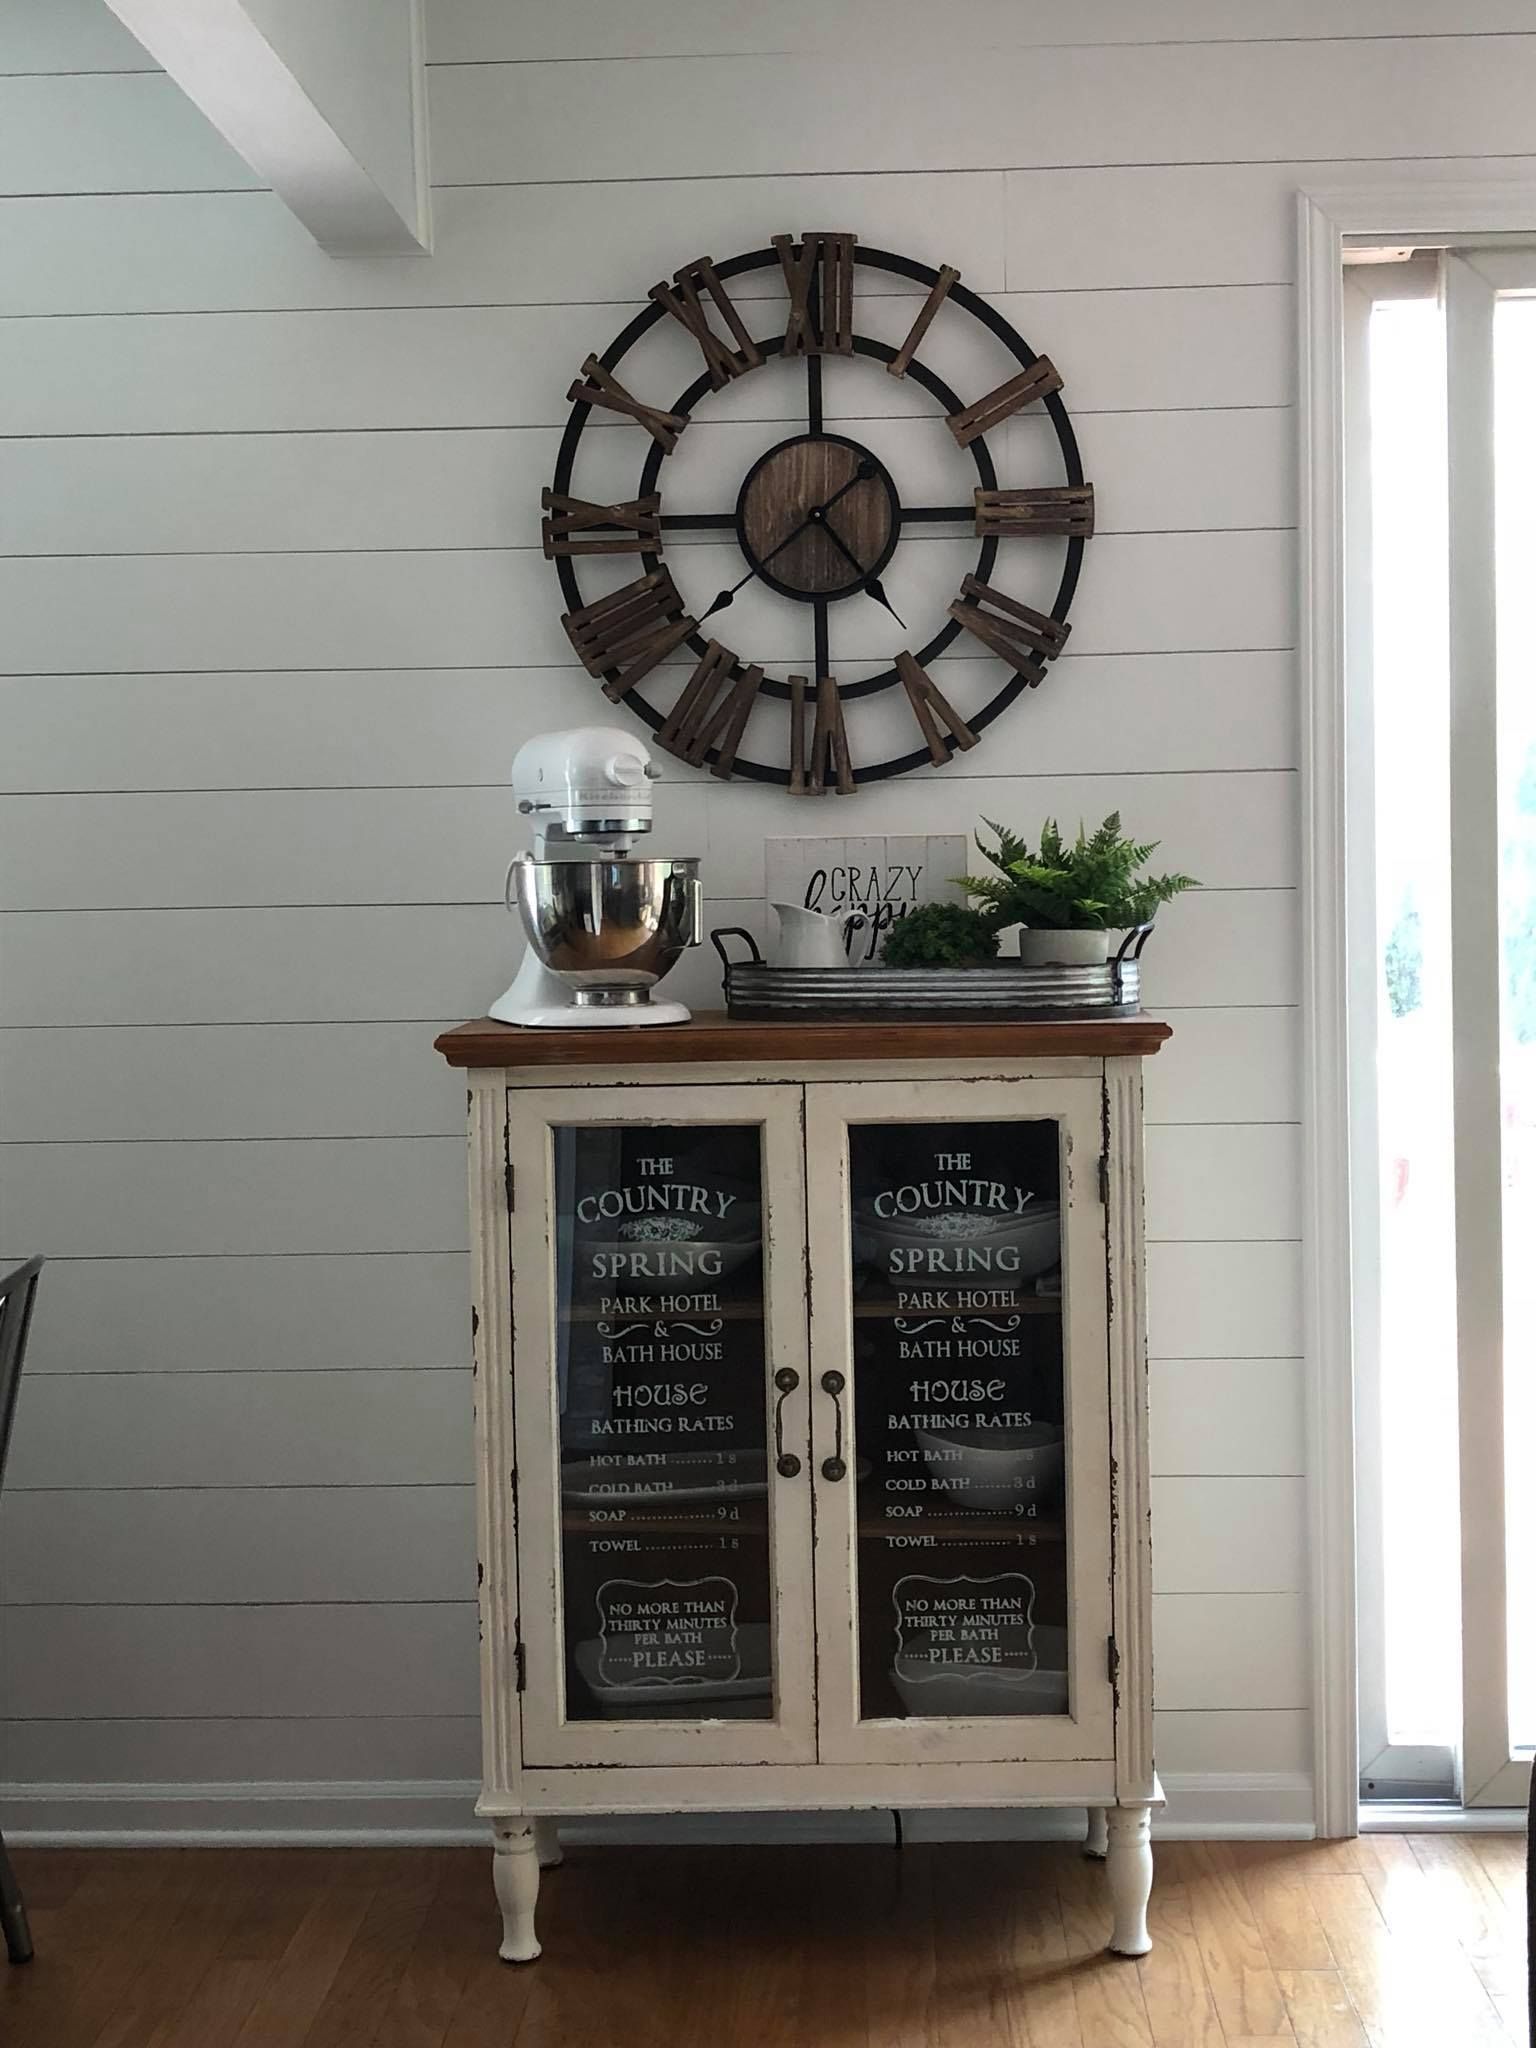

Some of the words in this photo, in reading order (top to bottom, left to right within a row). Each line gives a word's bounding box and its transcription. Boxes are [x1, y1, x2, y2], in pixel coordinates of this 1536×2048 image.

[831, 866, 923, 901] CRAZY
[637, 1158, 674, 1175] THE
[934, 1153, 971, 1170] THE
[577, 1184, 736, 1223] COUNTRY
[874, 1180, 1035, 1218] COUNTRY
[592, 1251, 723, 1279] SPRING
[889, 1246, 1021, 1273] SPRING
[601, 1296, 653, 1314] PARK
[661, 1294, 722, 1312] HOTEL
[898, 1292, 950, 1310] PARK
[958, 1290, 1019, 1308] HOTEL
[654, 1320, 670, 1338] &
[951, 1316, 967, 1333] &
[603, 1345, 654, 1363] BATH
[661, 1343, 723, 1361] HOUSE
[900, 1341, 950, 1359] BATH
[958, 1339, 1021, 1357] HOUSE
[591, 1418, 672, 1434] BATHING
[678, 1416, 734, 1432] RATES
[888, 1414, 969, 1429] BATHING
[975, 1412, 1032, 1428] RATES
[590, 1455, 622, 1467] HOT
[627, 1454, 667, 1466] BATH
[886, 1450, 919, 1462] HOT
[924, 1450, 962, 1462] BATH
[589, 1483, 630, 1496] COLD
[885, 1479, 926, 1491] COLD
[931, 1478, 970, 1490] BATH
[589, 1511, 627, 1522] SOAP
[885, 1506, 923, 1518] SOAP
[589, 1540, 641, 1552] TOWEL
[886, 1536, 938, 1548] TOWEL
[609, 1604, 632, 1615] NO
[637, 1602, 679, 1615] MORE
[683, 1601, 725, 1613] THAN
[905, 1600, 929, 1612] NO
[934, 1599, 976, 1611] MORE
[981, 1598, 1022, 1609] THAN
[608, 1619, 662, 1631] THIRTY
[666, 1617, 727, 1630] MINUTES
[904, 1615, 957, 1627] THIRTY
[962, 1614, 1024, 1626] MINUTES
[634, 1633, 660, 1645] PER
[664, 1632, 702, 1644] BATH
[931, 1630, 956, 1642] PER
[960, 1628, 999, 1640] BATH
[633, 1651, 706, 1667] PLEASE
[929, 1648, 1002, 1664] PLEASE
